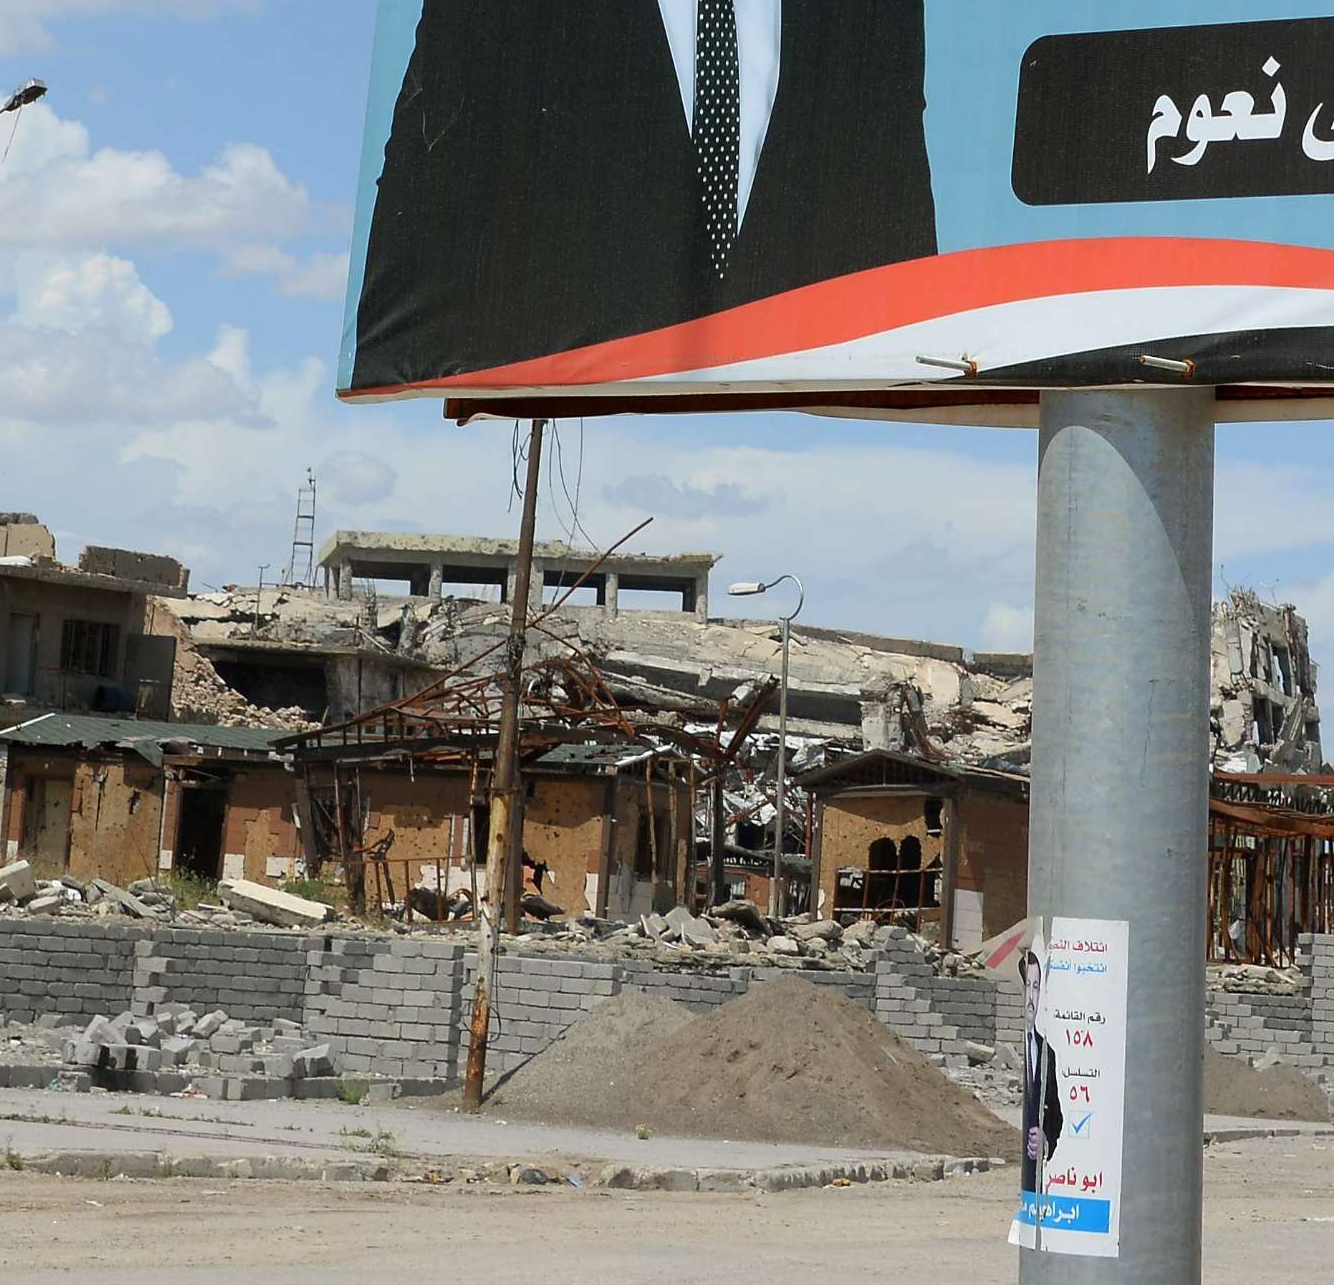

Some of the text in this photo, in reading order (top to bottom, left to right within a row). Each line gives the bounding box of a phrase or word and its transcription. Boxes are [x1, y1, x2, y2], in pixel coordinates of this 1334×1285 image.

[1147, 55, 1286, 174] نعوم
[1087, 1011, 1106, 1024] رقم
[1066, 1028, 1093, 1047] ١٥٨
[1069, 1085, 1089, 1102] ٥٦
[1047, 1167, 1103, 1193] ابو ناصر
